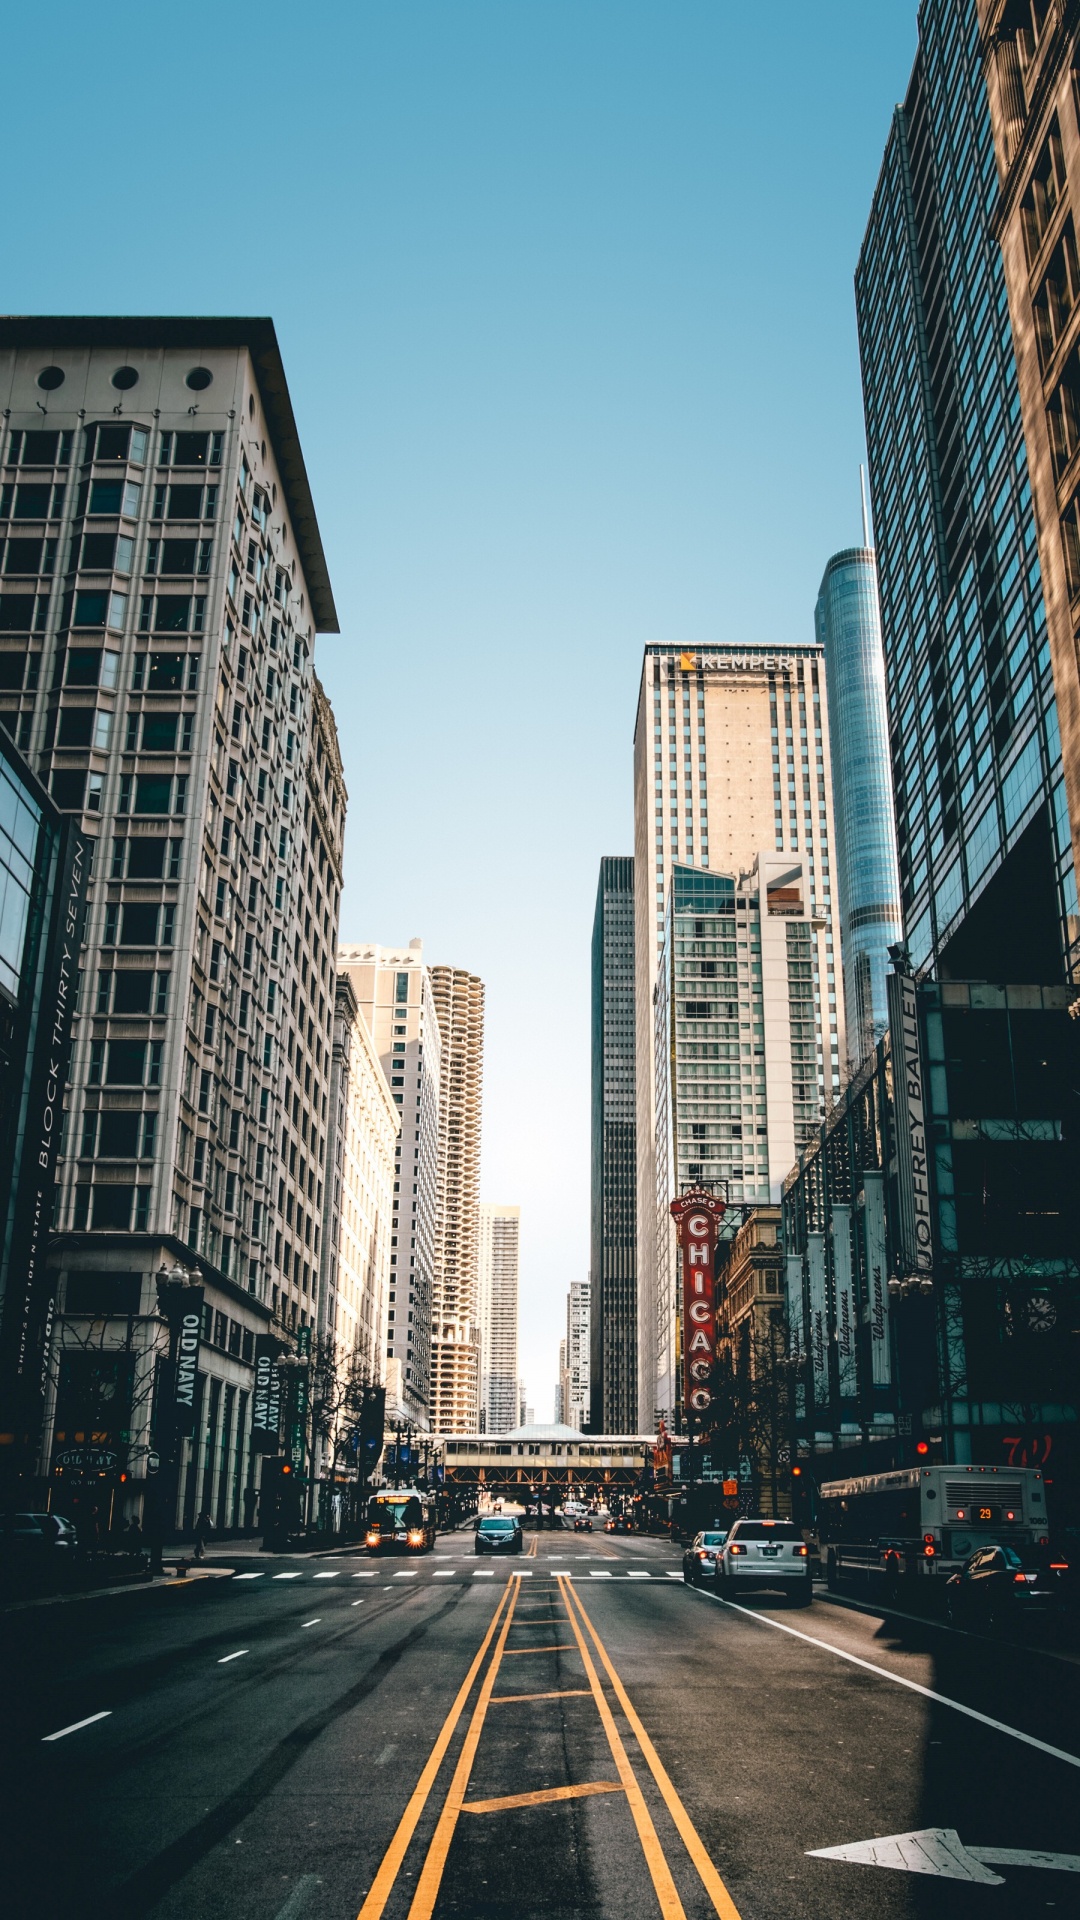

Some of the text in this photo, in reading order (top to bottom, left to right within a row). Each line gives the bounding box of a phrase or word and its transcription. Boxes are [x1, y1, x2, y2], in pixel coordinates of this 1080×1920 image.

[702, 655, 791, 670] KEMPER
[38, 841, 84, 1169] BLOCK THIRTY SEVEN
[902, 978, 932, 1268] JOFFREY BALLET
[33, 1190, 42, 1238] STATE
[681, 1198, 708, 1208] CHASE
[31, 1245, 36, 1253] N
[24, 1296, 30, 1314] AT
[45, 1298, 55, 1338] OLD
[688, 1214, 712, 1411] CHICAGO
[839, 1290, 854, 1359] Walgreens
[872, 1265, 888, 1341] Walgreens
[18, 1322, 28, 1374] SHOPS
[176, 1314, 200, 1407] OLD NAVY
[253, 1356, 271, 1430] OLD NAVY
[979, 1508, 992, 1519] 29
